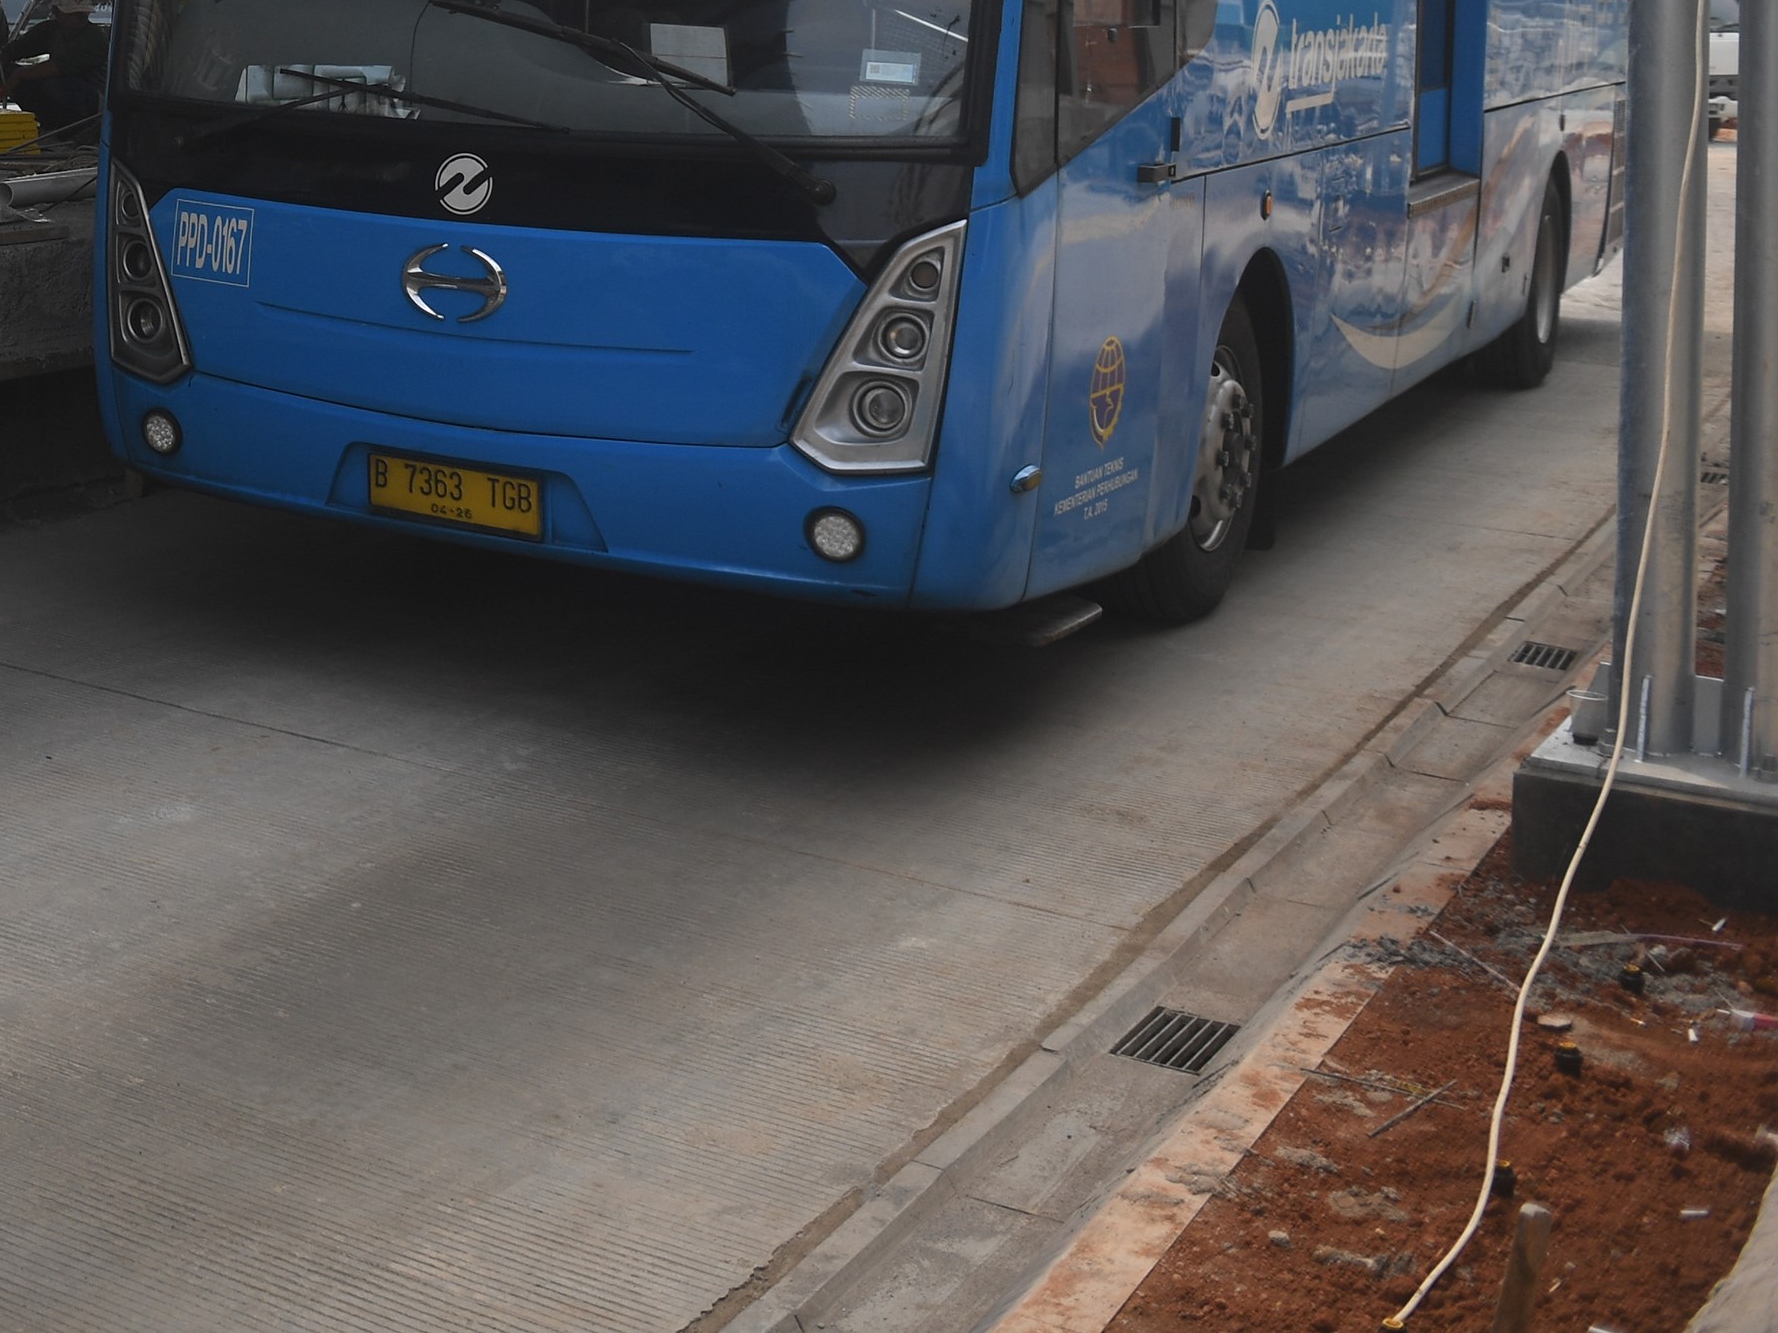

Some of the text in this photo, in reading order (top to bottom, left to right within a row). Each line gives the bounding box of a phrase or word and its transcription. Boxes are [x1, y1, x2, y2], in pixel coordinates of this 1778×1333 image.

[1288, 11, 1387, 104] transjakarta
[177, 211, 248, 275] PPD-0167
[376, 460, 532, 514] B 7363 TGB
[1054, 469, 1139, 515] KEMENTERIAN PERHUBUNGAN
[1076, 457, 1124, 488] BANTUAN TEKNIS
